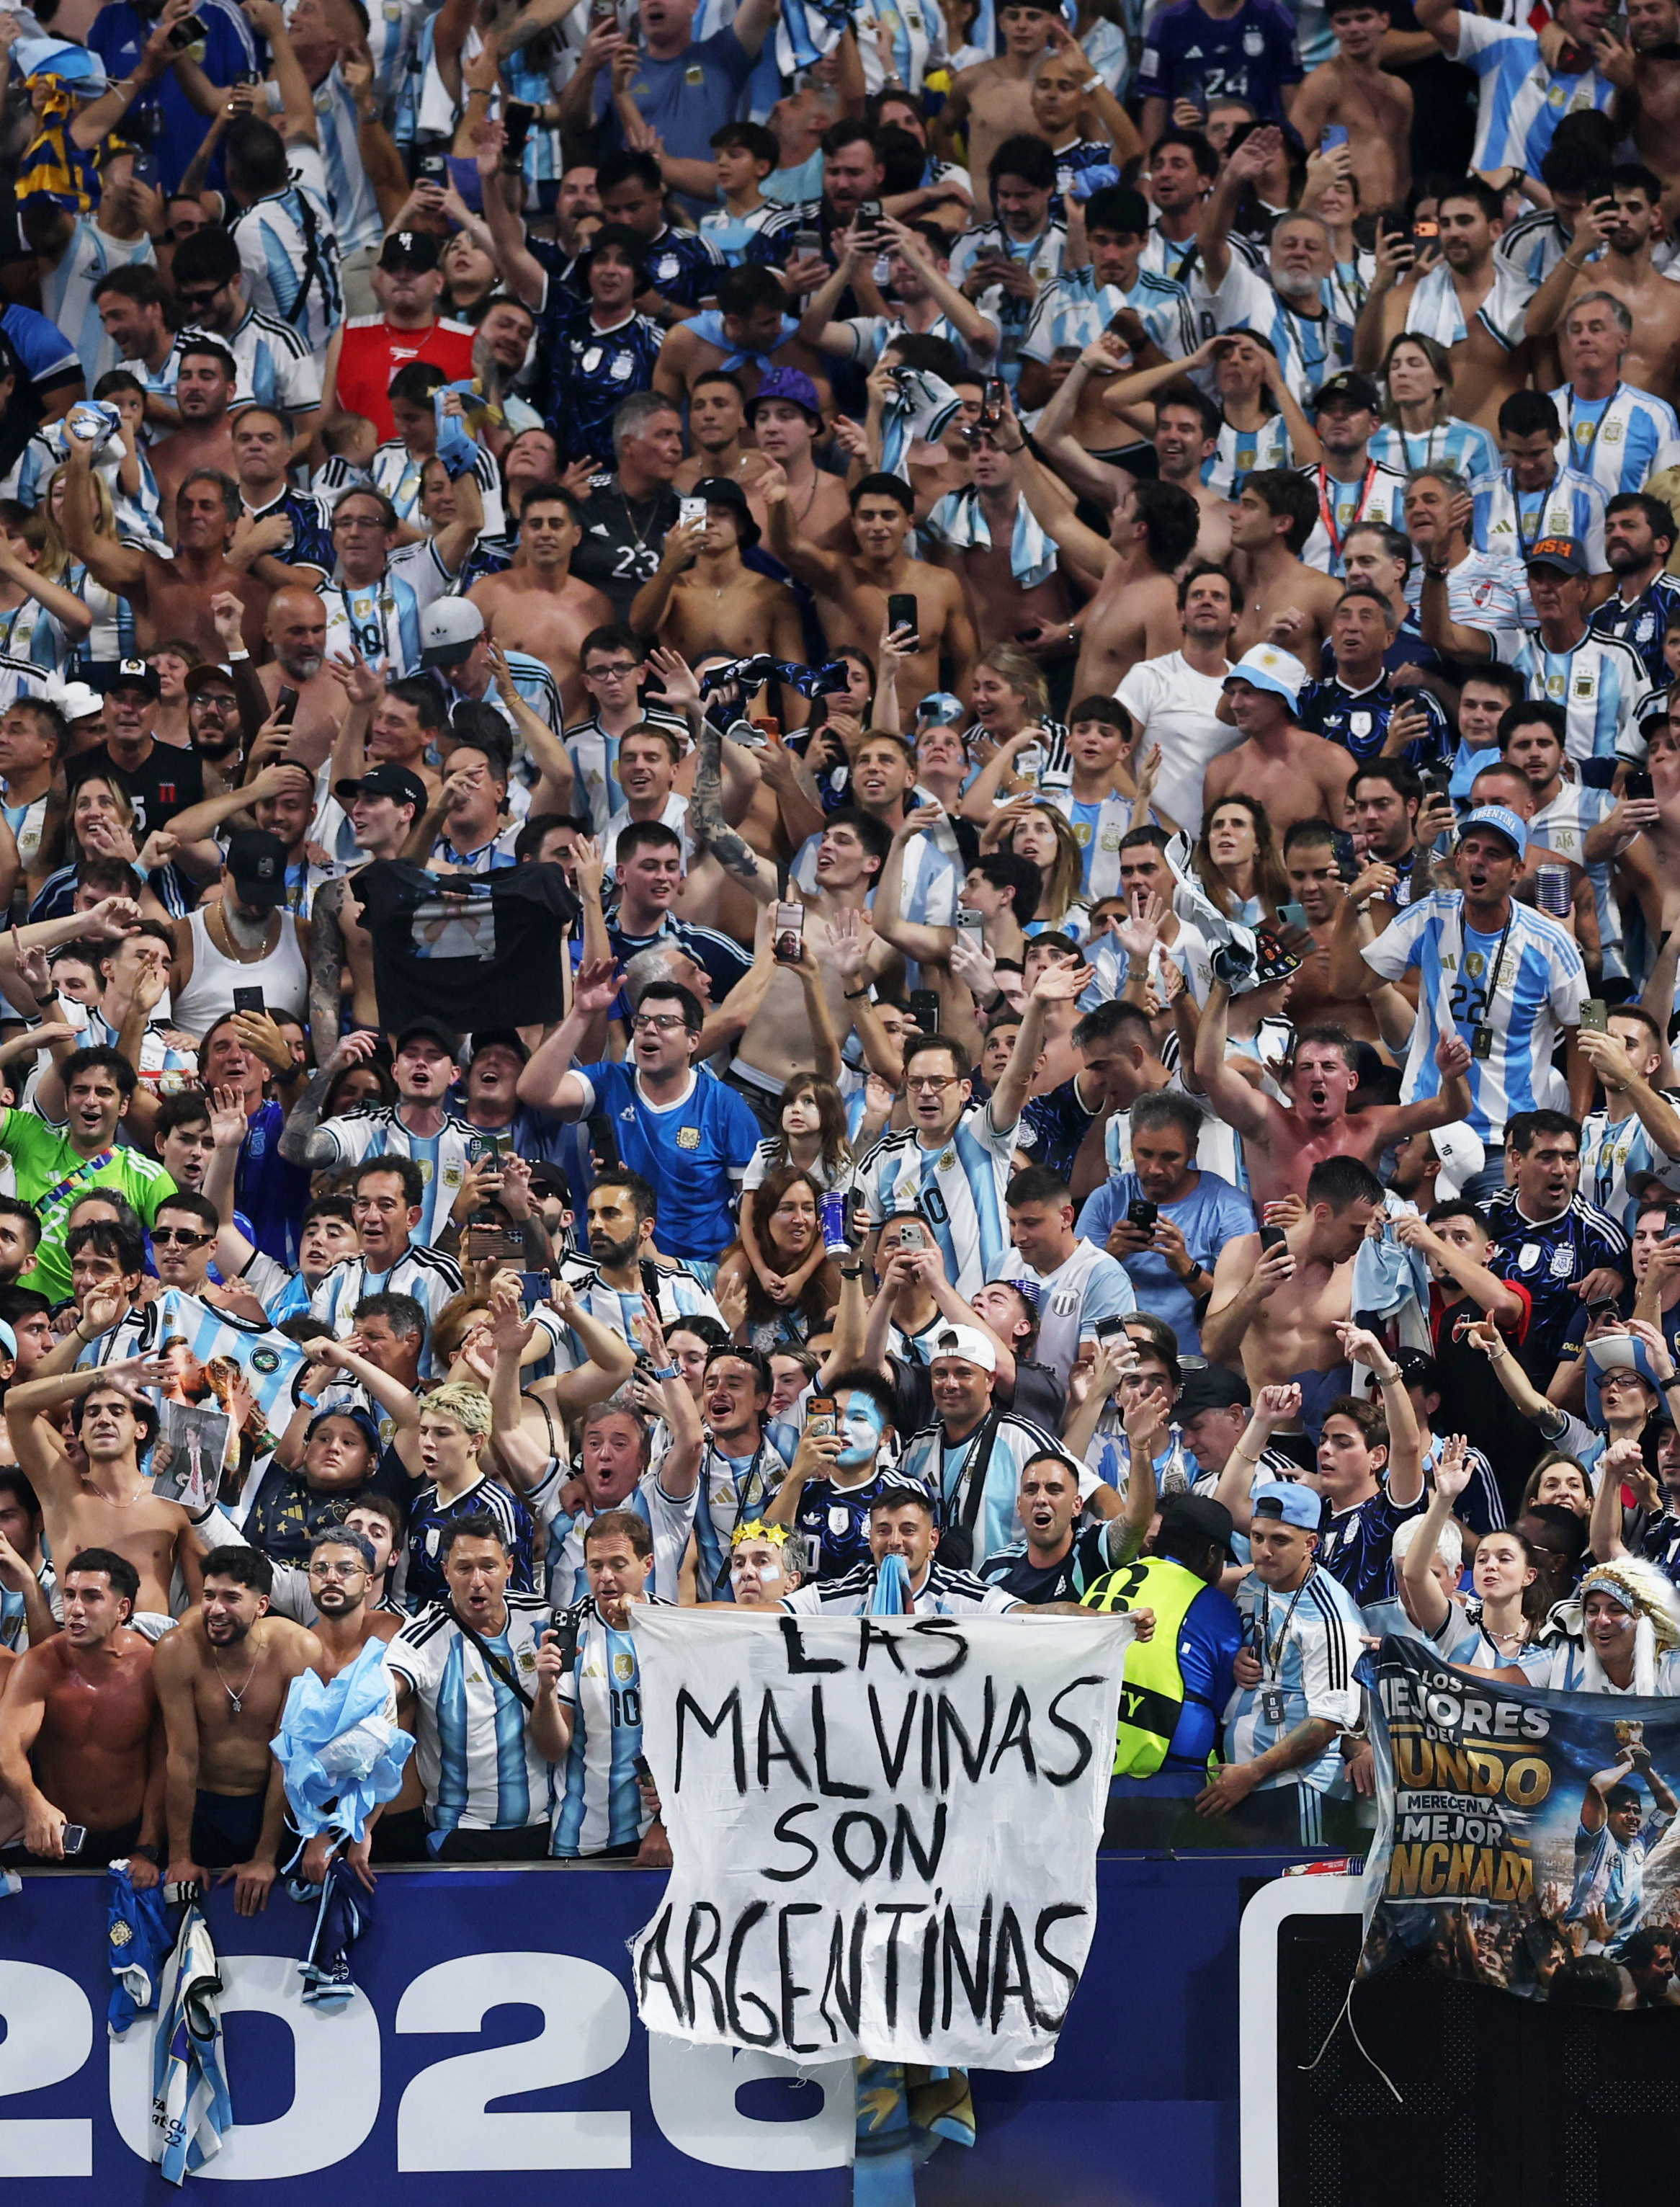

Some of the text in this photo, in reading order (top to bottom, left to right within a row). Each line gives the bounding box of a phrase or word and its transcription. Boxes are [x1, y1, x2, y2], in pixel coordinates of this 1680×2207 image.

[1205, 66, 1248, 99] 24
[612, 545, 660, 581] 23
[1473, 808, 1516, 832] ARGENTINA
[1555, 831, 1575, 852] AFA
[1449, 984, 1487, 1026] 22
[1441, 1144, 1453, 1156] 10
[41, 1204, 68, 1247] 2
[1555, 1257, 1568, 1270] AFA
[779, 1616, 970, 1679] LAS
[1422, 1669, 1462, 1693] LOS
[610, 1688, 643, 1729] 10
[674, 1675, 1109, 1799] MALVINAS
[1426, 1723, 1459, 1747] DEL
[1391, 1738, 1552, 1806] UNDO
[760, 1802, 947, 1883] SON
[1402, 1815, 1503, 1847] MEJOR
[1389, 1842, 1534, 1904] NCHADA
